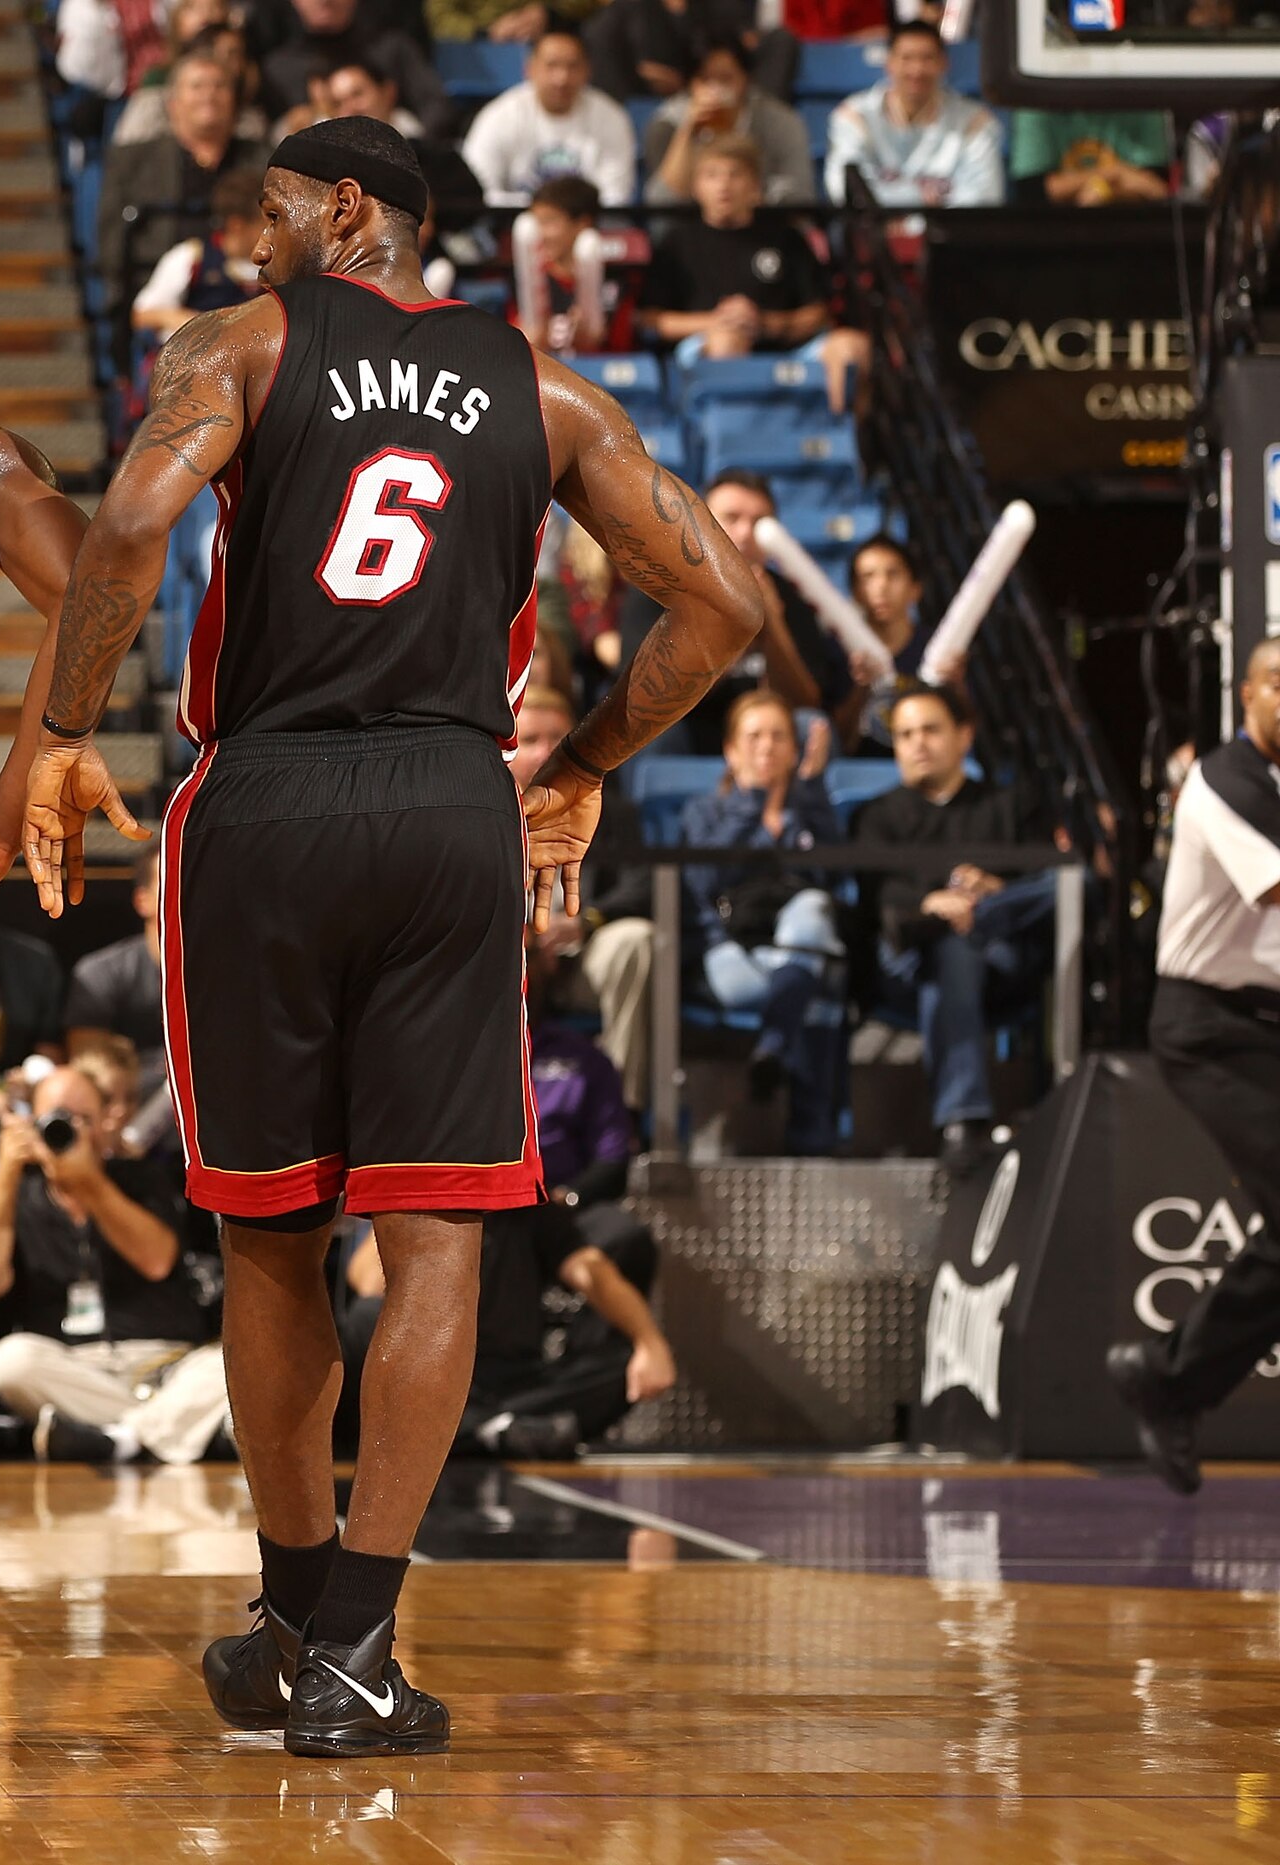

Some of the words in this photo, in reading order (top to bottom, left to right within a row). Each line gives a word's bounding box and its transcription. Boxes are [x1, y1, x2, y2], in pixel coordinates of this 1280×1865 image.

[327, 358, 491, 435] JAMES
[313, 446, 454, 608] 6
[1132, 1196, 1265, 1264] CA
